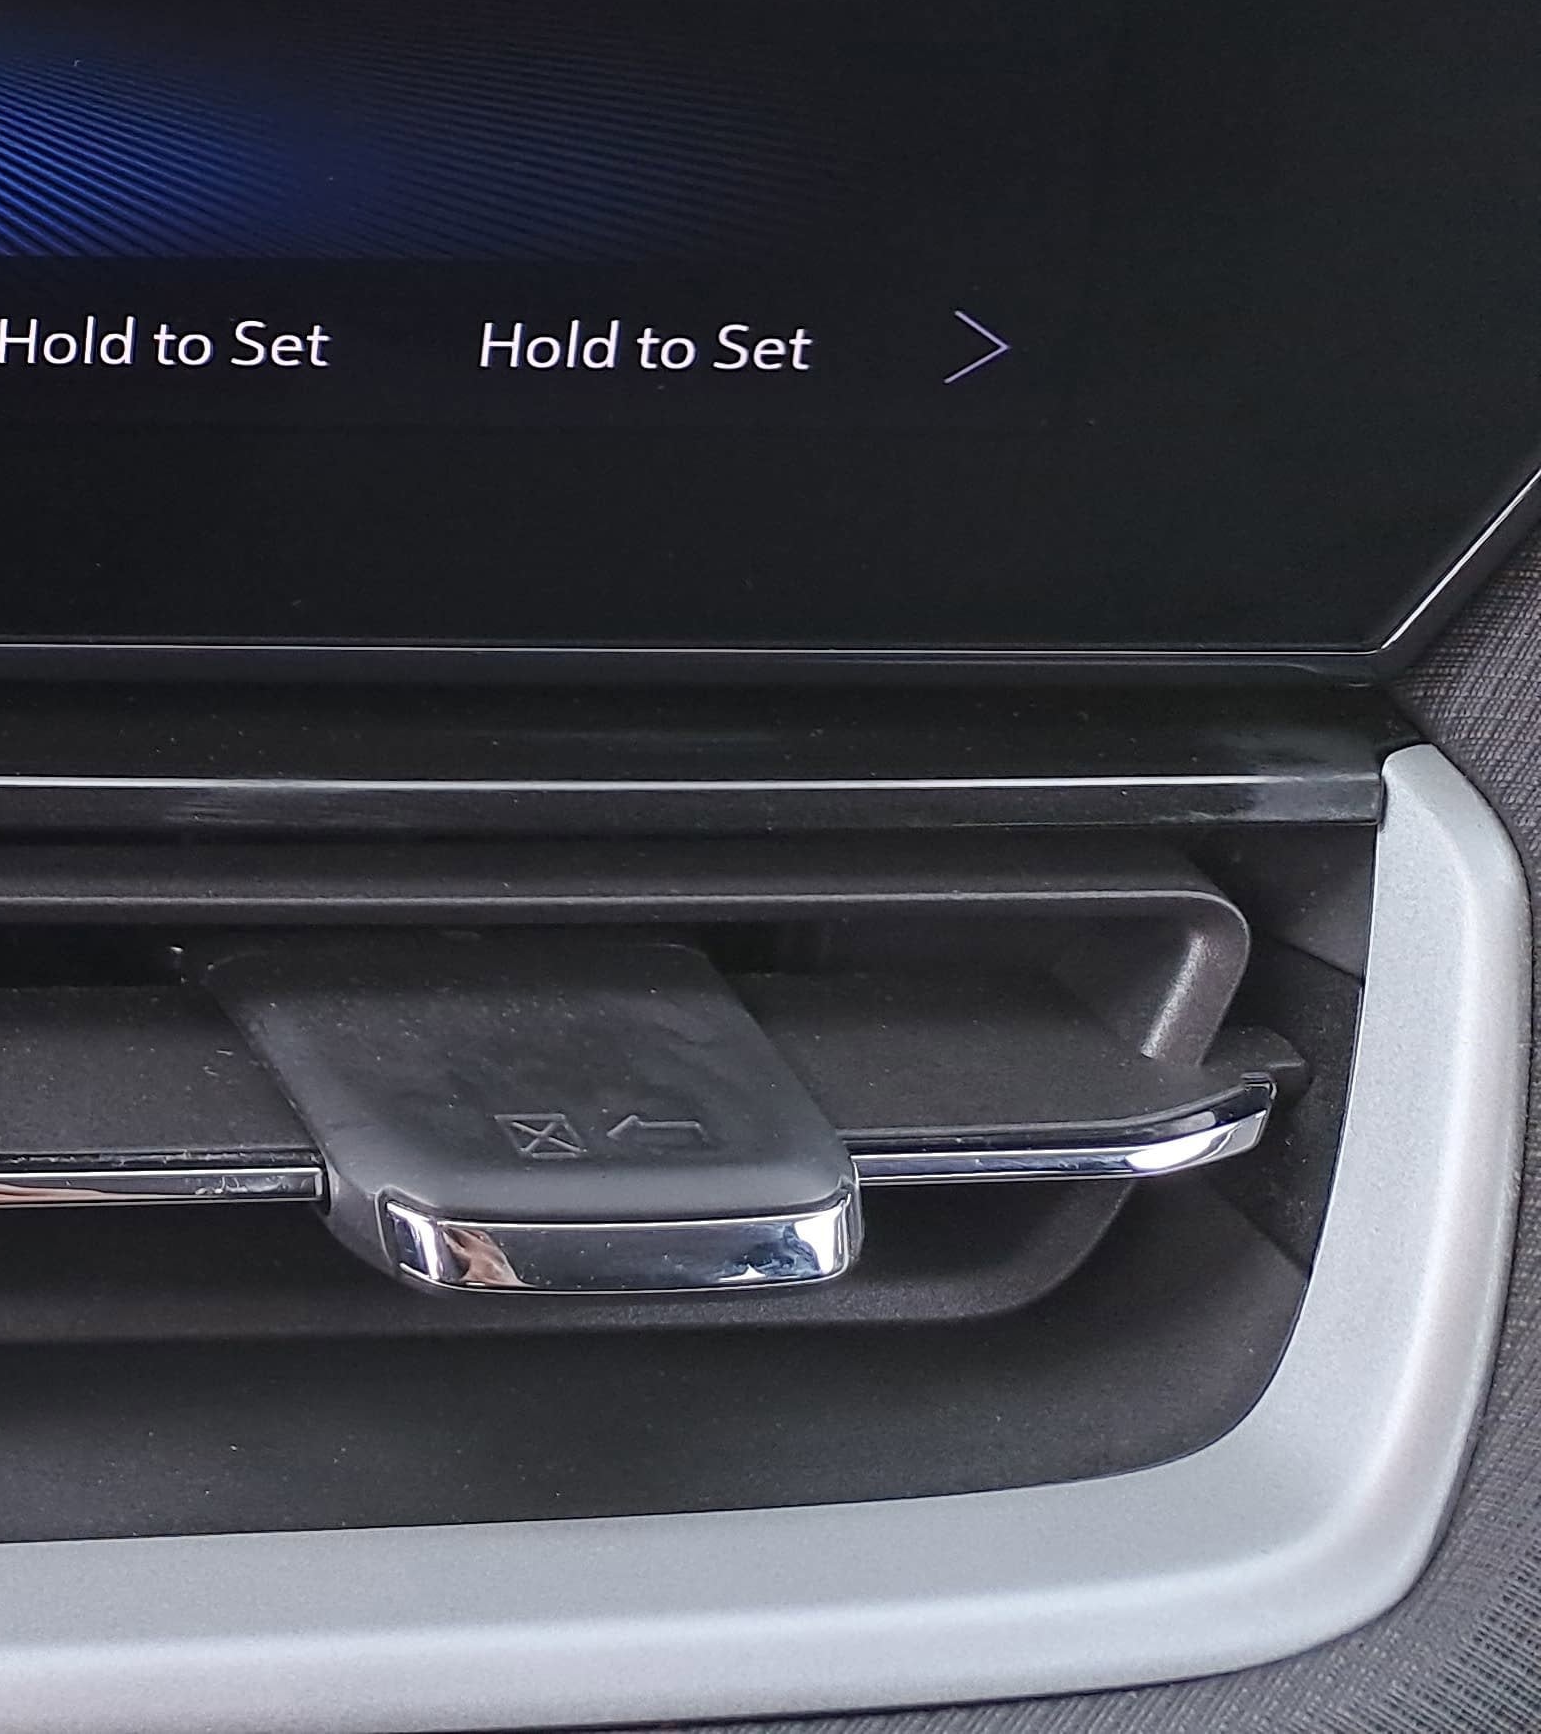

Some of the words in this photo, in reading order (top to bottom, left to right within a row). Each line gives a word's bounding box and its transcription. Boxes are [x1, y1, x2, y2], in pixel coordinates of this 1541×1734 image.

[153, 323, 213, 367] to
[230, 320, 332, 367] Set
[479, 319, 621, 370] Hold
[636, 327, 697, 370] to
[713, 323, 813, 371] Set
